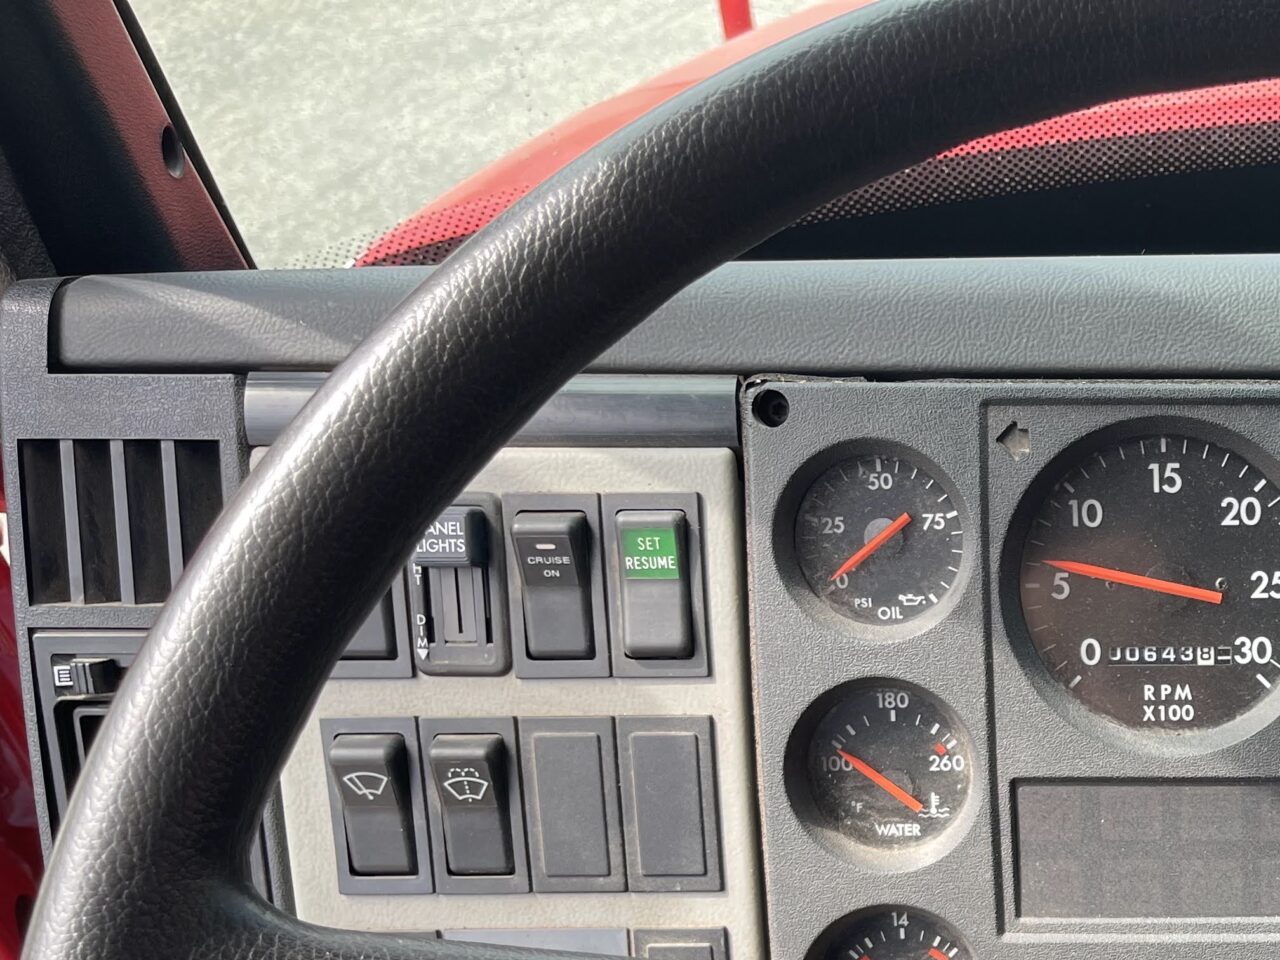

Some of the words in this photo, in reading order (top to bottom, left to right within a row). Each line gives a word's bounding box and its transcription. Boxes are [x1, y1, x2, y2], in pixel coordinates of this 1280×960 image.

[868, 473, 893, 490] 50
[1148, 463, 1183, 493] 15
[1068, 499, 1103, 528] 10
[1220, 497, 1262, 526] 20
[425, 521, 464, 536] ANEL
[822, 516, 845, 534] 25
[922, 513, 946, 530] 75
[416, 538, 466, 553] LIGHTS
[637, 537, 660, 551] SET
[527, 555, 571, 566] CRUISE
[625, 554, 676, 571] RESUME
[543, 568, 560, 578] ON
[836, 573, 849, 589] 0
[1051, 572, 1071, 600] 5
[854, 598, 873, 608] PSI
[878, 607, 904, 620] OIL
[1080, 638, 1101, 665] 0
[1234, 637, 1272, 664] 30
[876, 692, 909, 708] 180
[1144, 685, 1192, 700] RPM
[1143, 705, 1194, 721] X100
[821, 755, 852, 772] 100
[929, 755, 964, 771] 260
[875, 823, 921, 836] WATER
[891, 912, 909, 927] 14
